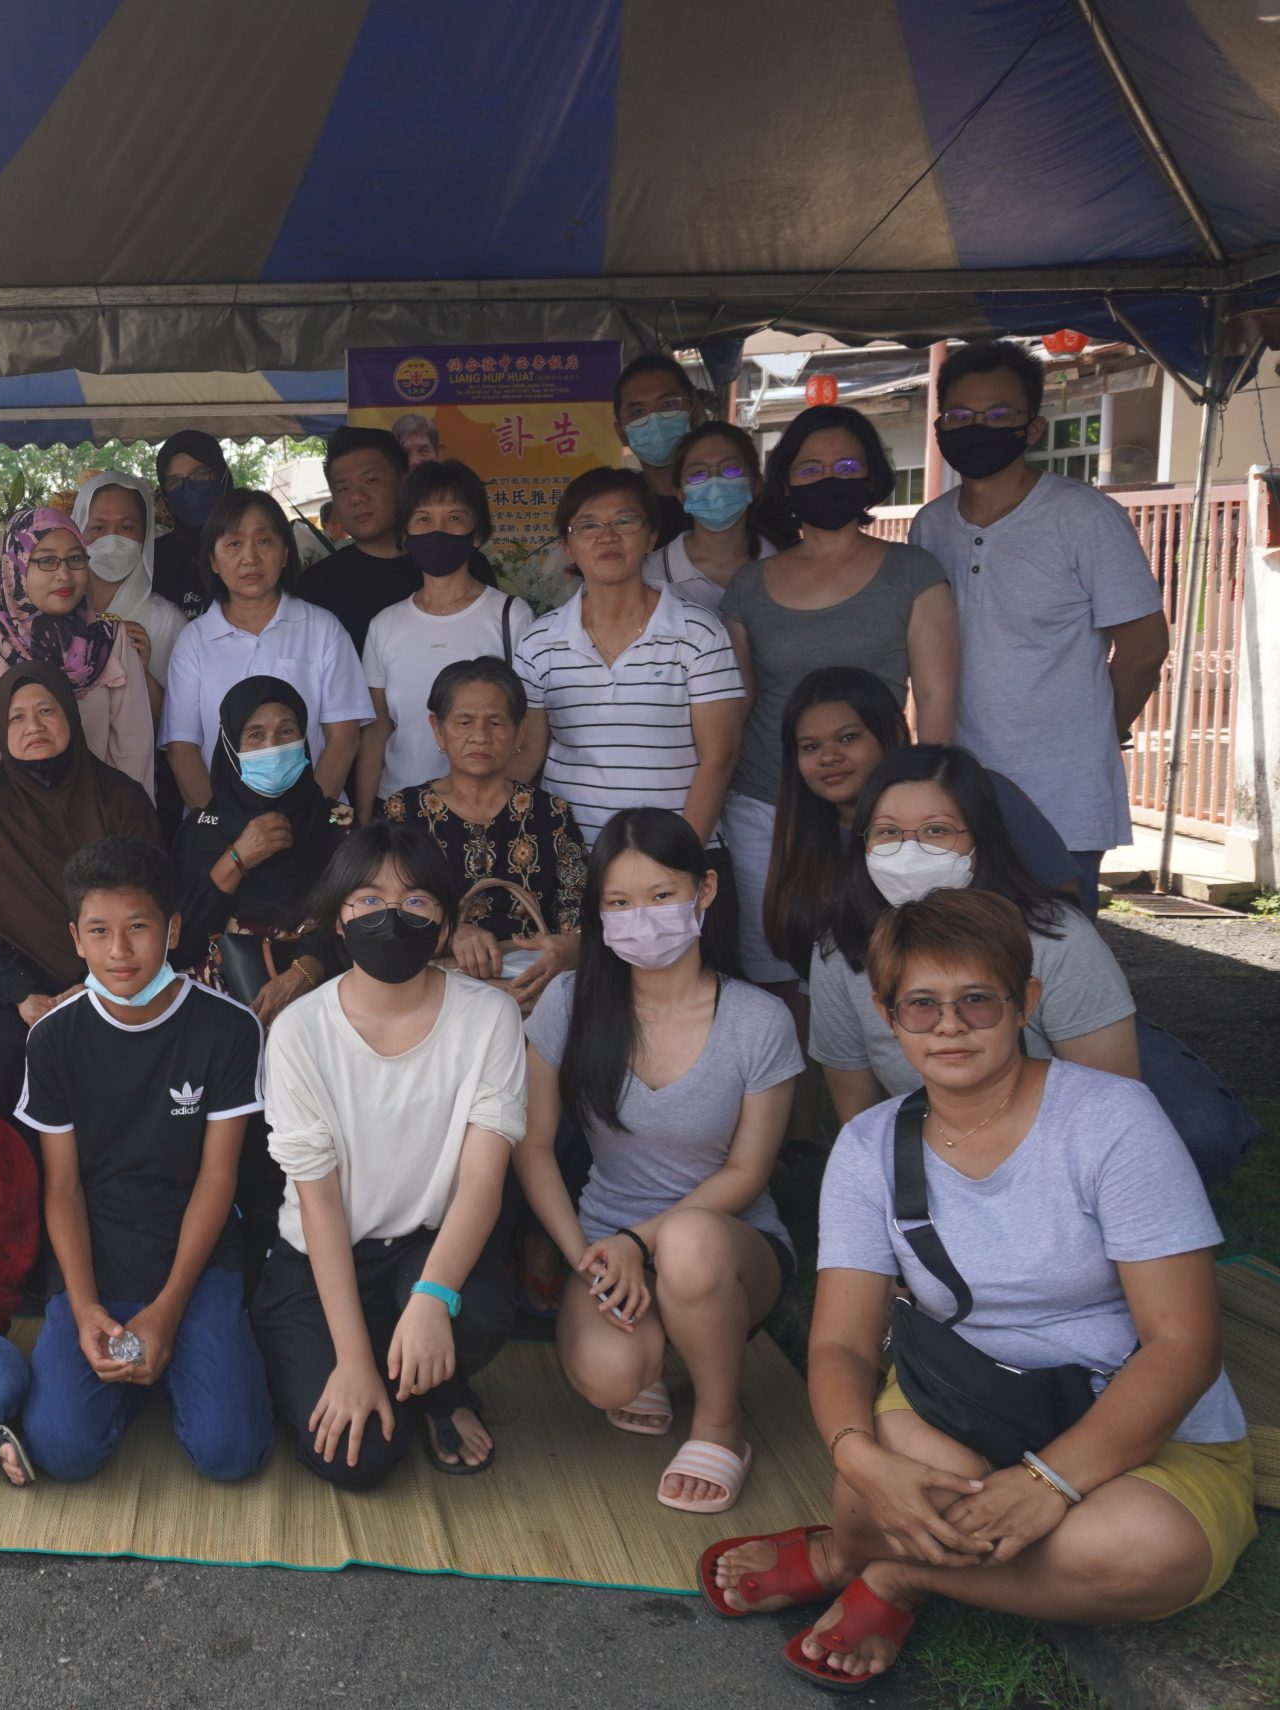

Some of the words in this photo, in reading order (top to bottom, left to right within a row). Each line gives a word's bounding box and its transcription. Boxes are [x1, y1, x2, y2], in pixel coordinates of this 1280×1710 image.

[449, 373, 481, 384] LIANG
[483, 372, 505, 383] HUP
[506, 371, 535, 383] HUAT
[494, 412, 582, 457] 訃告
[488, 488, 561, 506] 林氏雅長
[197, 811, 219, 825] love
